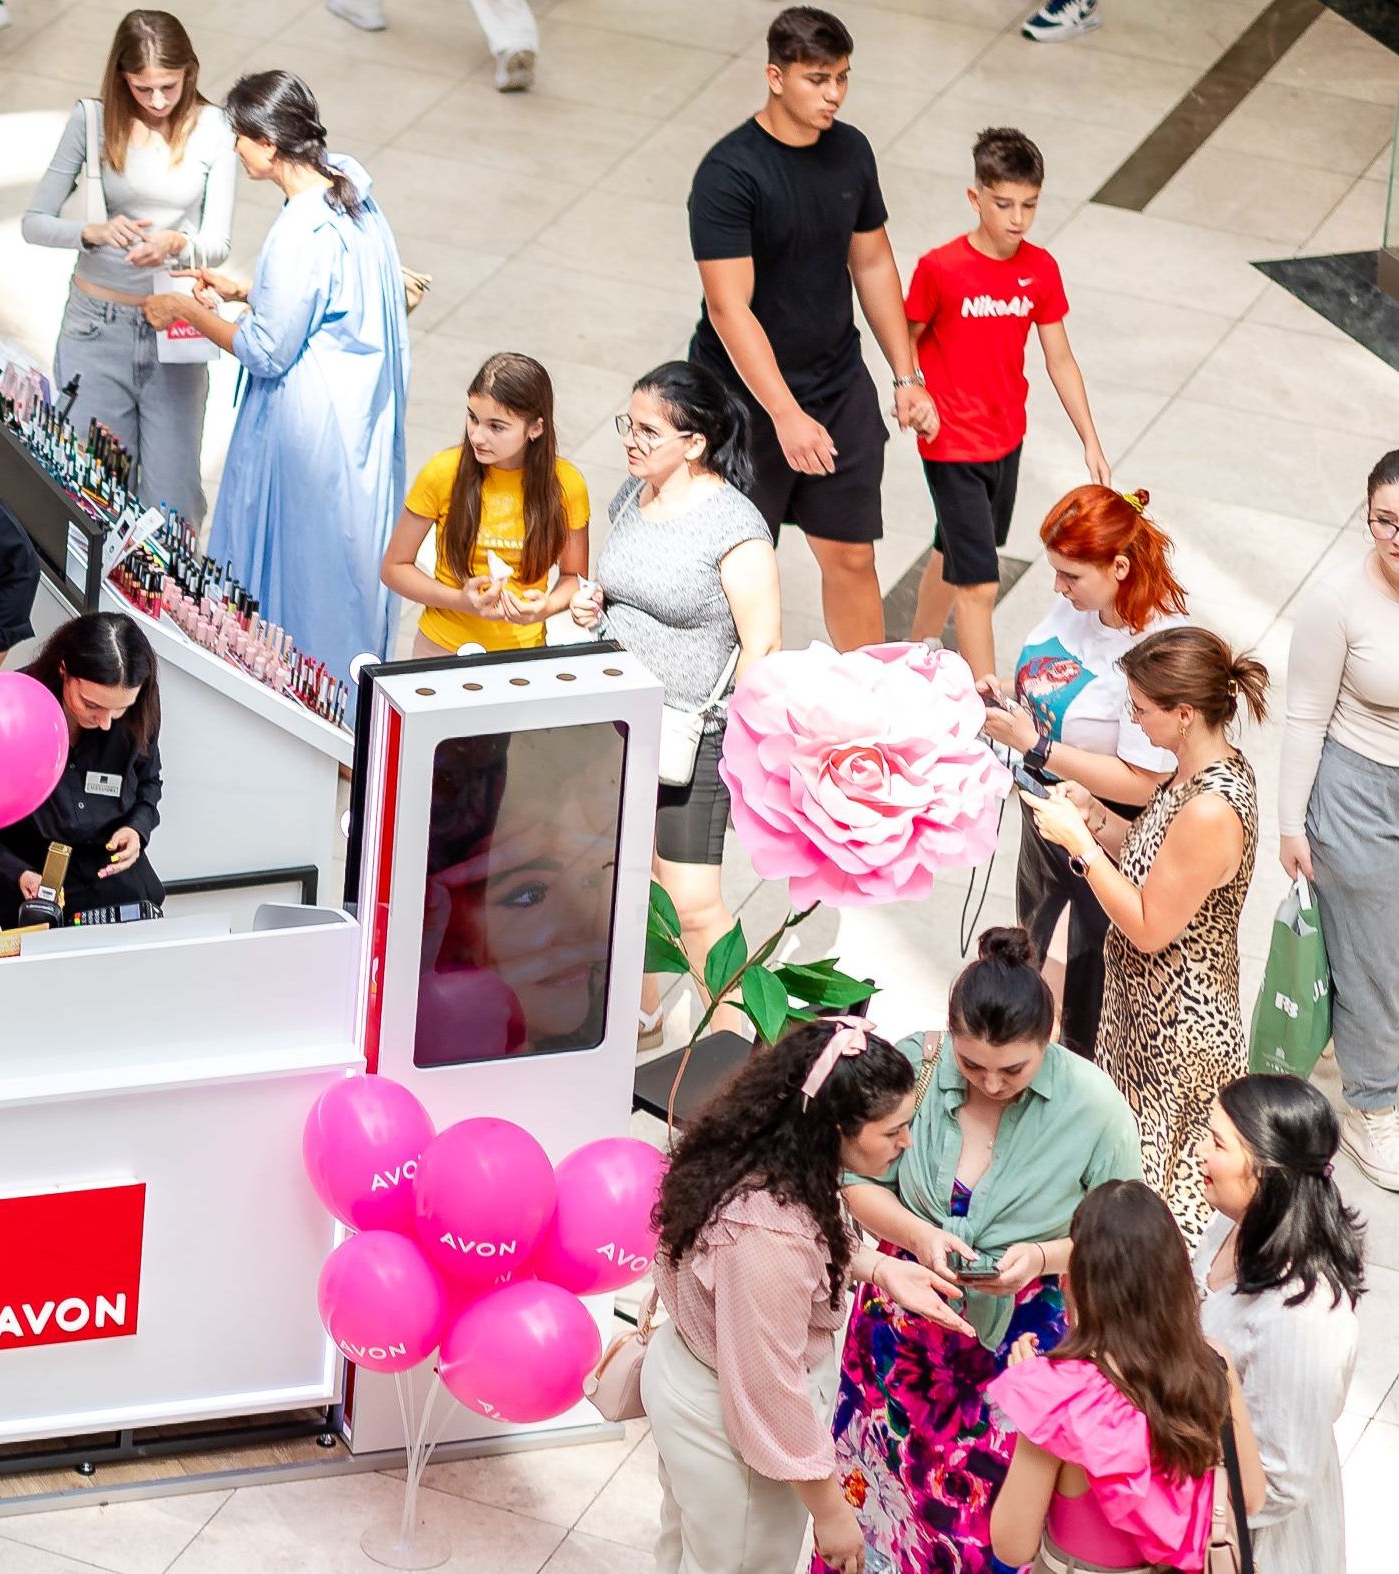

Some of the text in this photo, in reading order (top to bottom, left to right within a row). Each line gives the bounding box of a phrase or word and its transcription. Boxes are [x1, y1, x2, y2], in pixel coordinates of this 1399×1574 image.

[170, 326, 202, 337] AVO
[371, 1154, 422, 1192] AVO
[439, 1232, 517, 1257] AVON
[595, 1242, 649, 1272] AVO
[339, 1339, 407, 1360] AVON
